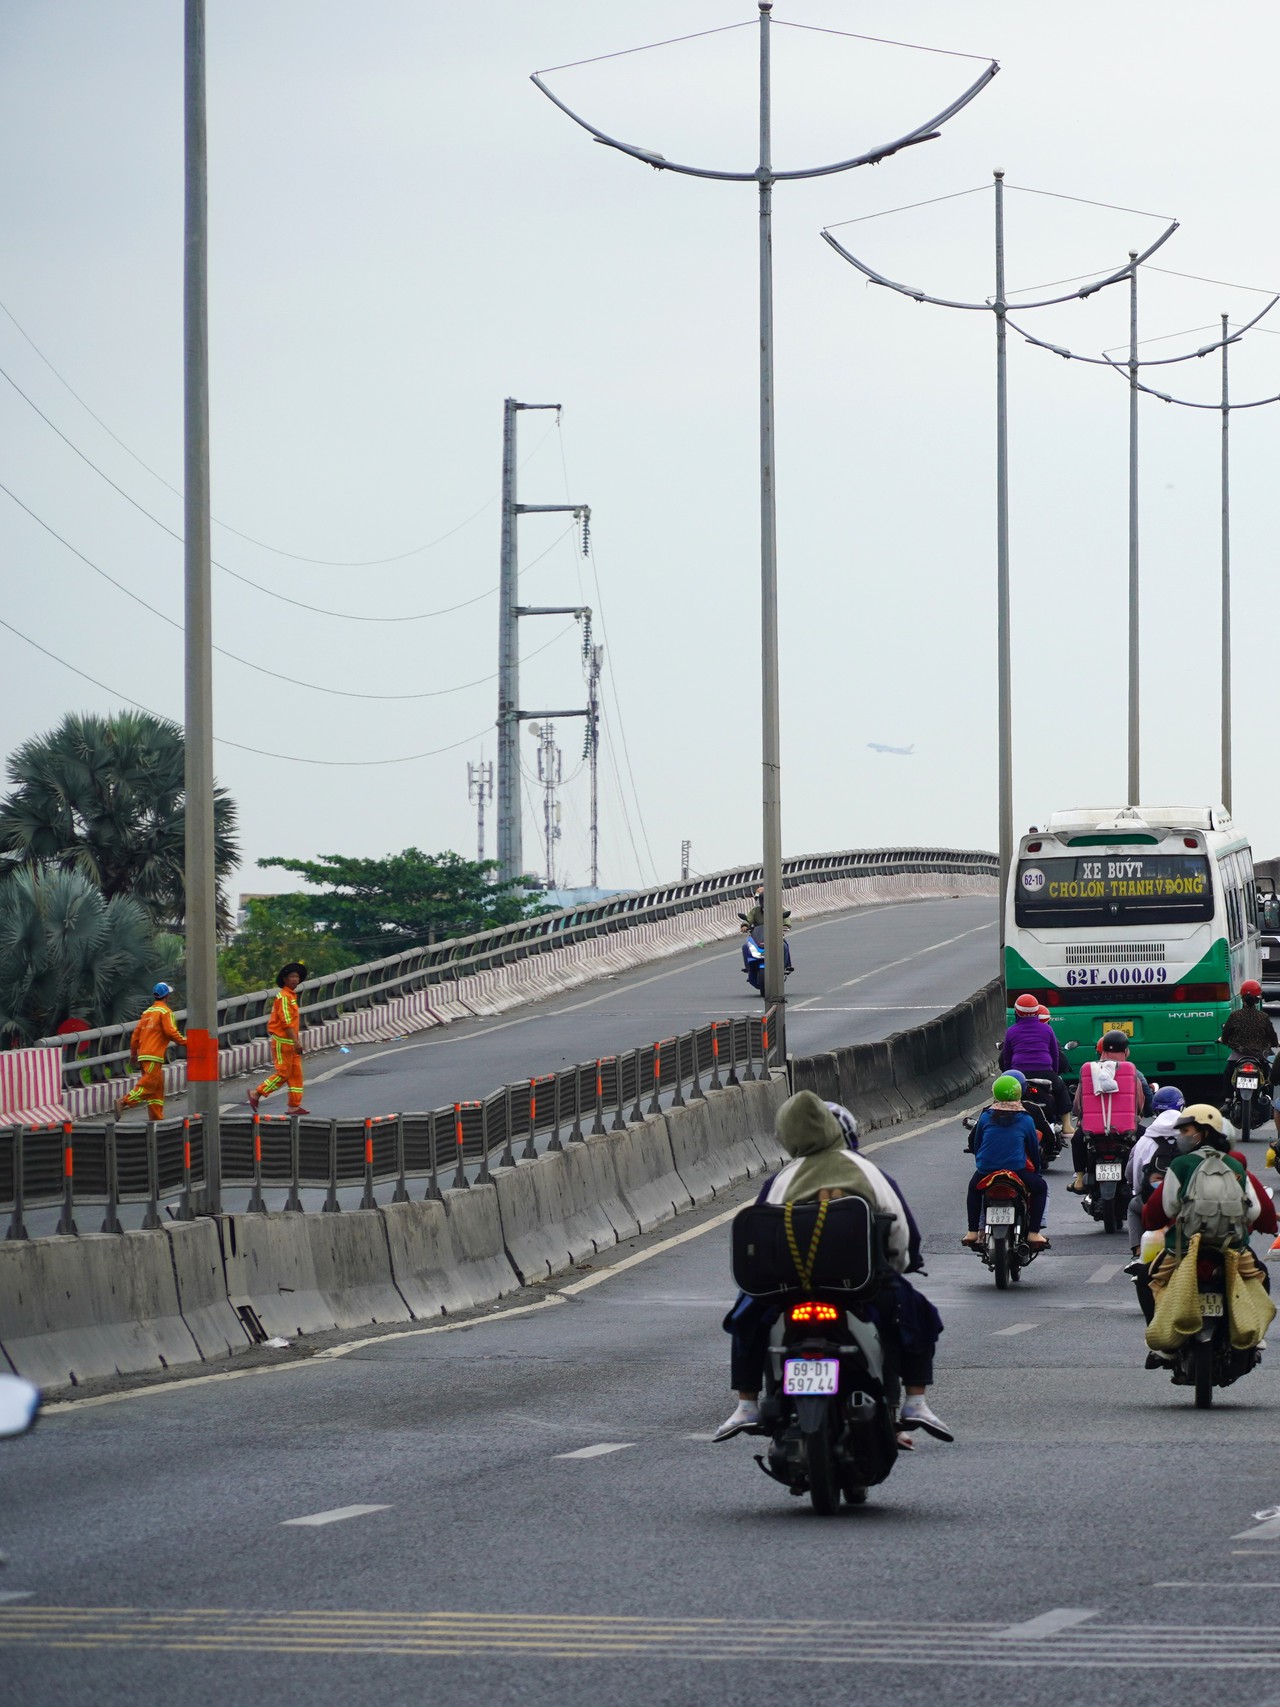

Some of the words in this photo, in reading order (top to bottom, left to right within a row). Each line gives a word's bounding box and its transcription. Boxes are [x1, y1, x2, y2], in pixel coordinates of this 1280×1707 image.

[1083, 862, 1101, 879] XE
[1107, 858, 1143, 878] BUÝT
[1024, 874, 1043, 886] 62-10
[793, 1362, 829, 1377] 69-D1
